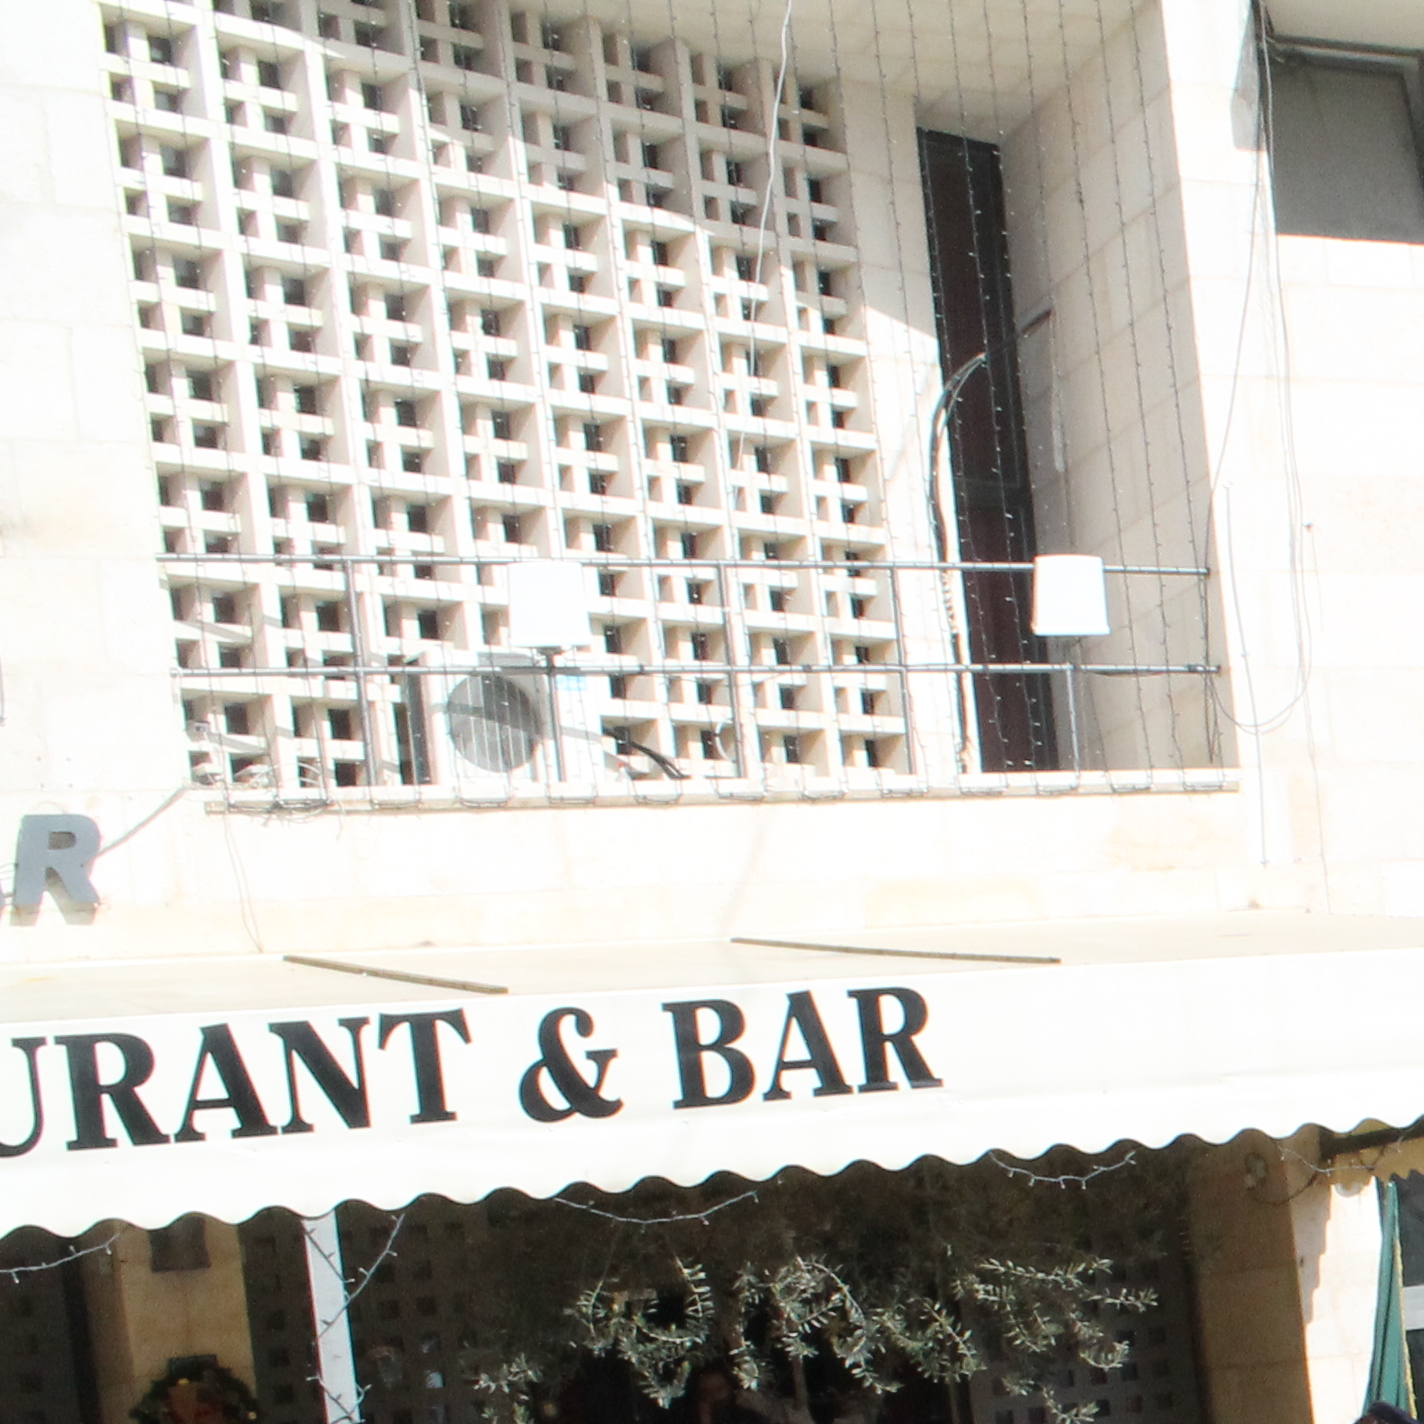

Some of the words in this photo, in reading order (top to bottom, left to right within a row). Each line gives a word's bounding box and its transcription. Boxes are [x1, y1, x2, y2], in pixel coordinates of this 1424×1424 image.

[9, 813, 101, 908] R
[517, 1005, 624, 1124] &
[661, 985, 944, 1110] BAR
